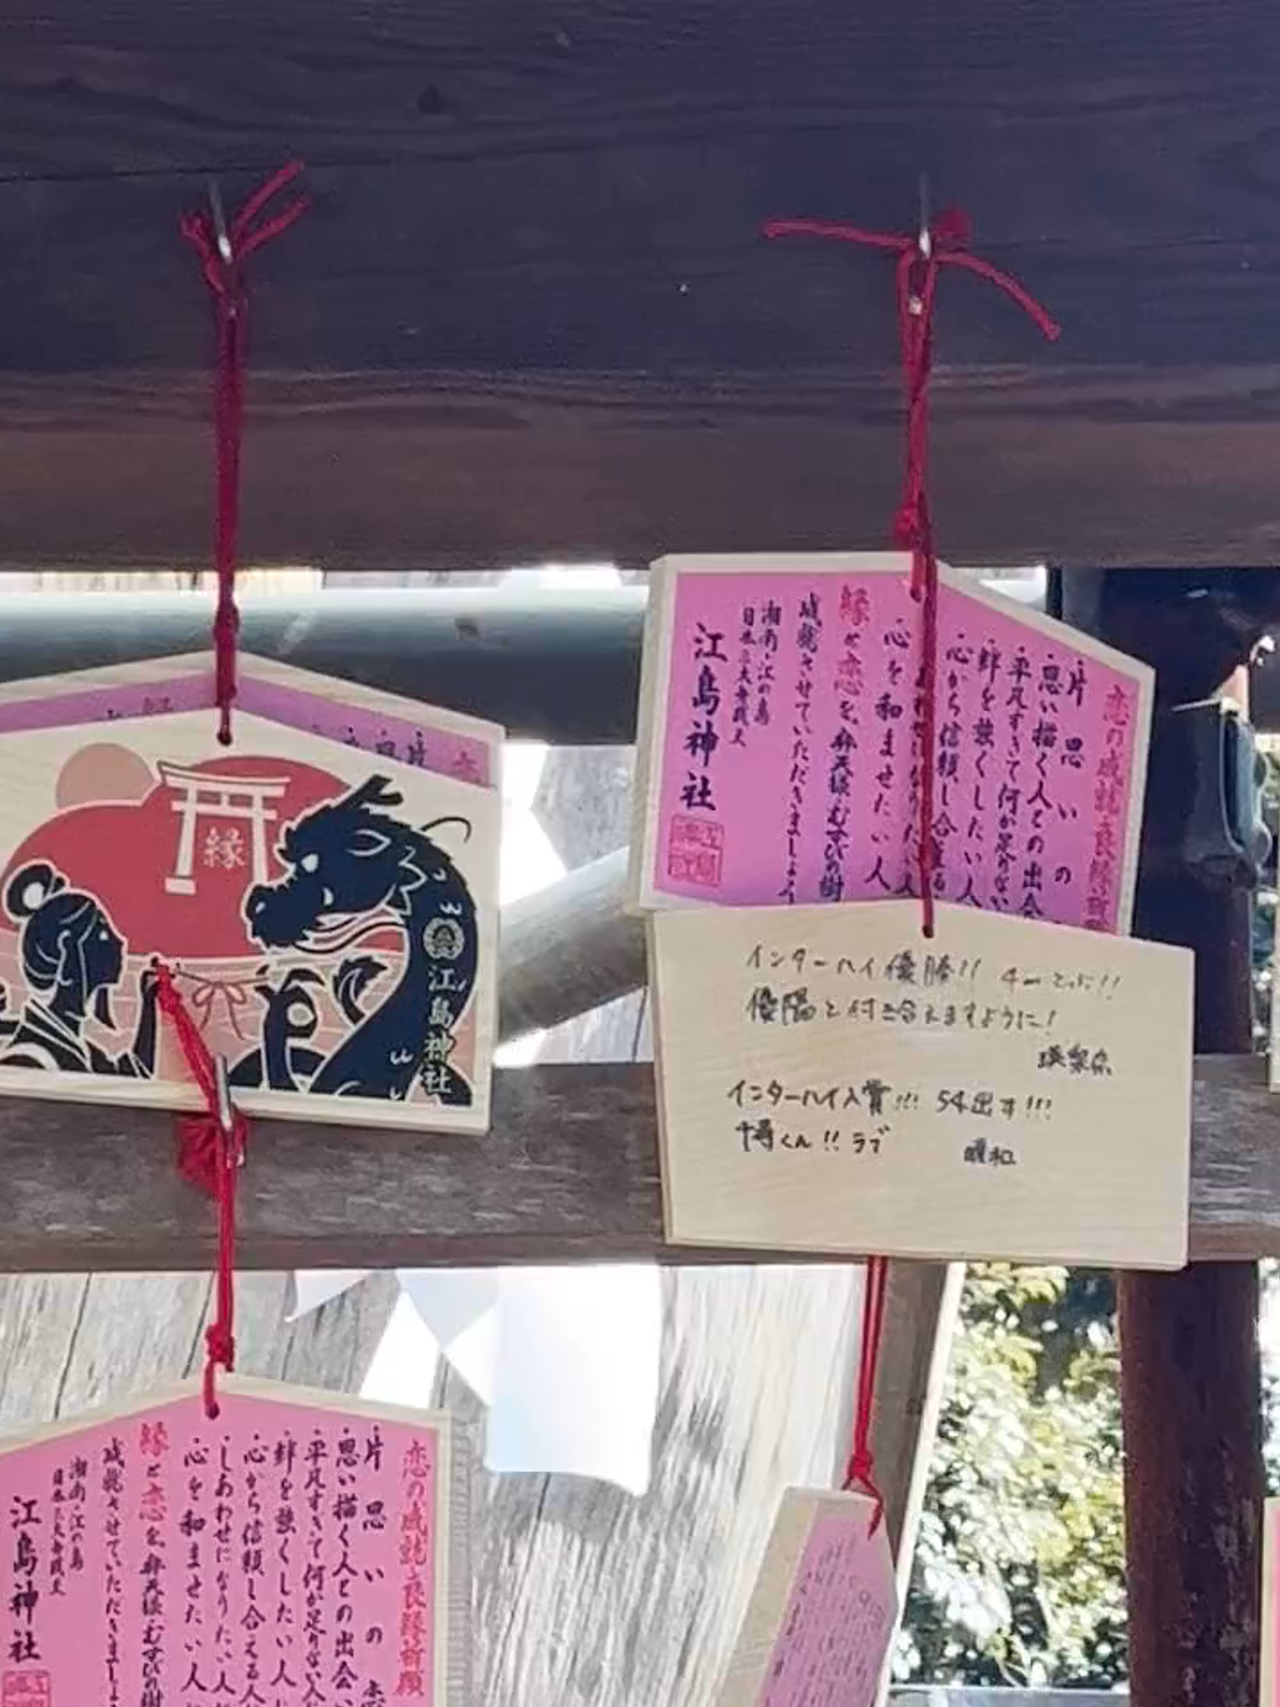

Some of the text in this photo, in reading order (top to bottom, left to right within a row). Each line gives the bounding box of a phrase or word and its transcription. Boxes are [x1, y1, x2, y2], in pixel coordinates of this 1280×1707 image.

[680, 622, 728, 811] 江島神社
[203, 827, 246, 870] 縁
[422, 966, 466, 1095] 江島神社
[7, 1495, 43, 1664] 江島神社
